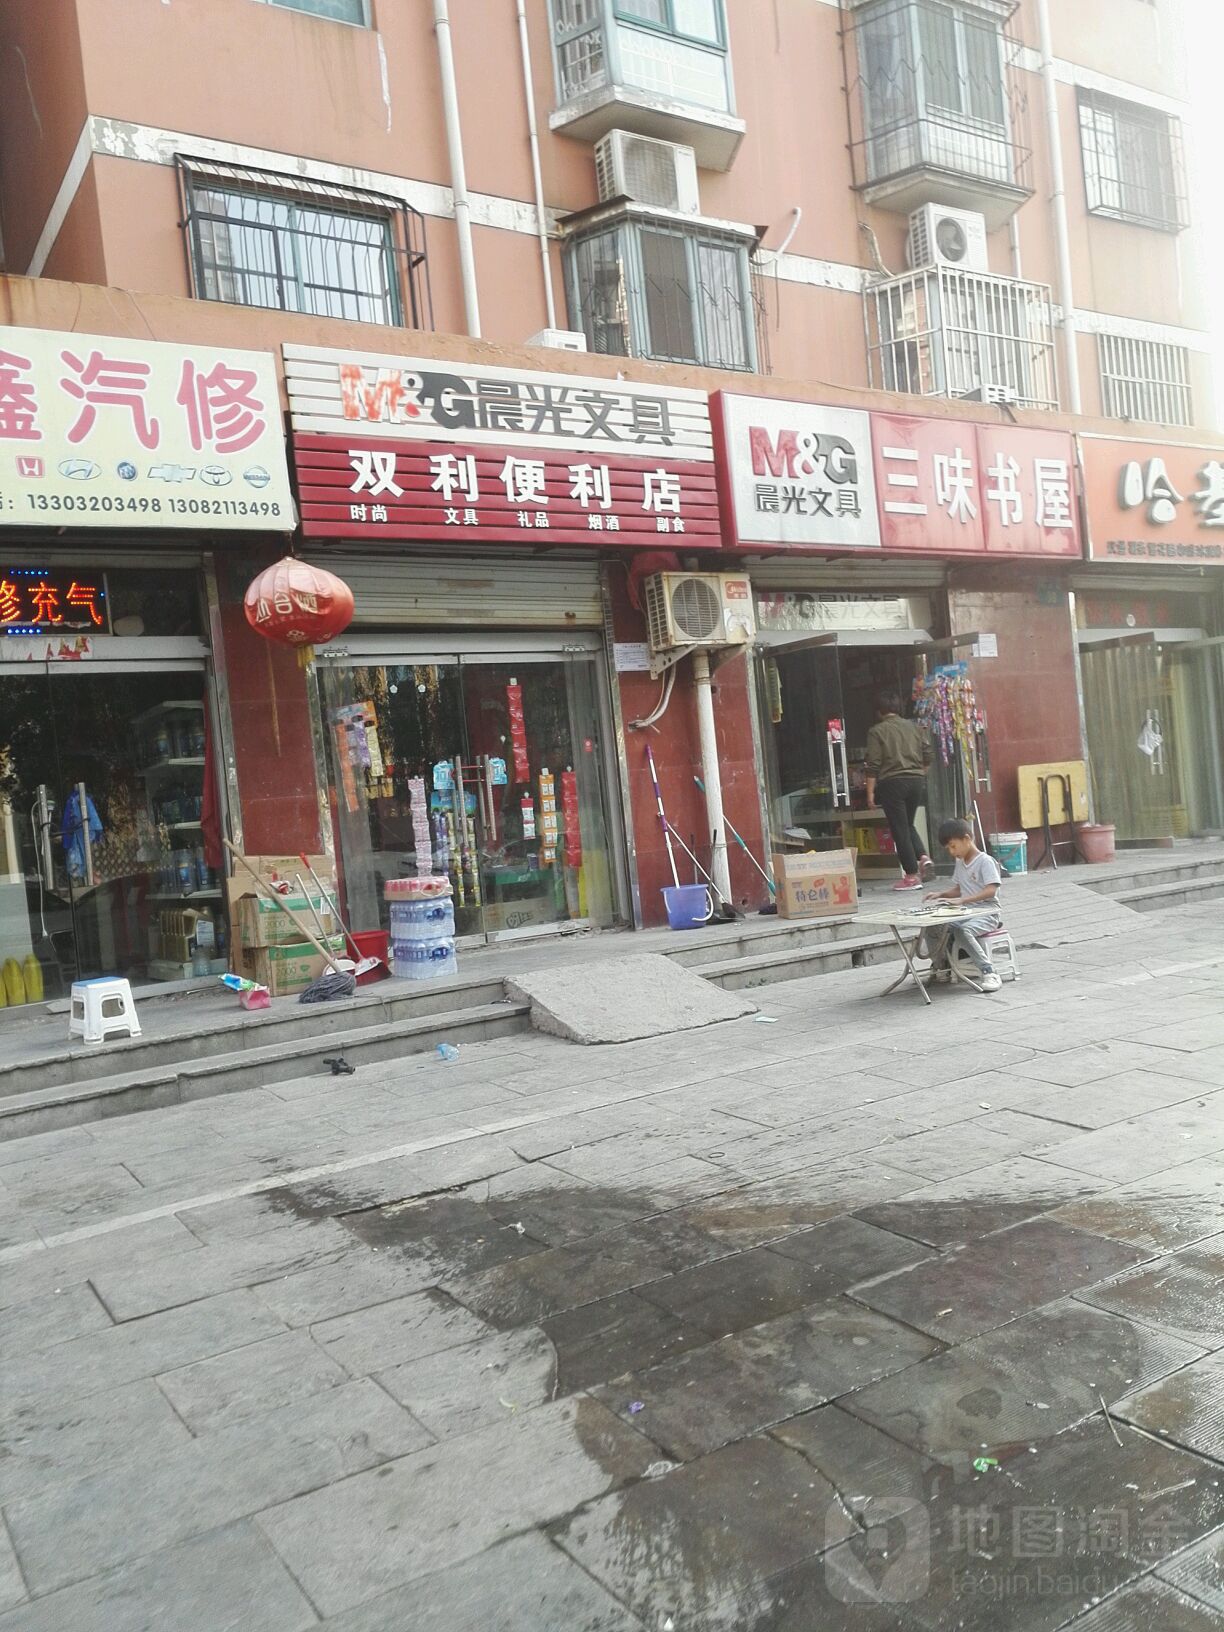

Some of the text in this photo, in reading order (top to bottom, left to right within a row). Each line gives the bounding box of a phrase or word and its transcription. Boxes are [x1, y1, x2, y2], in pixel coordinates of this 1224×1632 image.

[476, 380, 676, 446] 晨光文具
[348, 449, 682, 513] 双利便利店
[749, 425, 859, 484] M&G
[27, 494, 162, 513] 13303203498
[168, 498, 281, 517] 13082113498
[754, 483, 861, 518] 晨光文具
[881, 446, 1073, 528] 三味书屋
[350, 504, 686, 534] 时尚 文具 礼品 烟酒 副食
